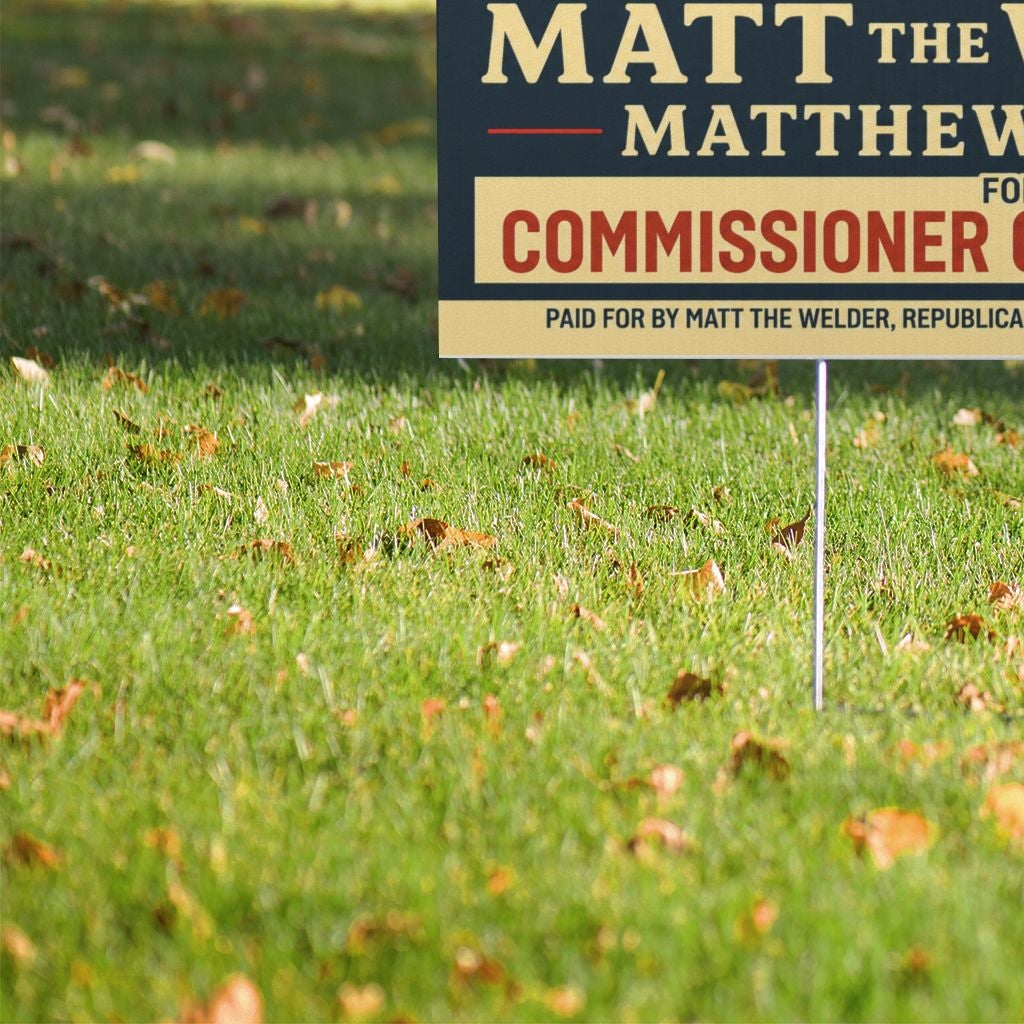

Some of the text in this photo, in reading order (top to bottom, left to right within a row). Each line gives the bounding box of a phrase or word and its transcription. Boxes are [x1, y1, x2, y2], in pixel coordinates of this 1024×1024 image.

[483, 4, 854, 84] MATT
[870, 24, 990, 64] THE
[504, 211, 989, 274] COMMISSIONER
[548, 309, 596, 329] PAID
[605, 309, 645, 329] FOR
[654, 310, 679, 329] BY
[688, 309, 744, 329] MATT
[751, 309, 792, 329] THE
[800, 309, 896, 331] WELDER,
